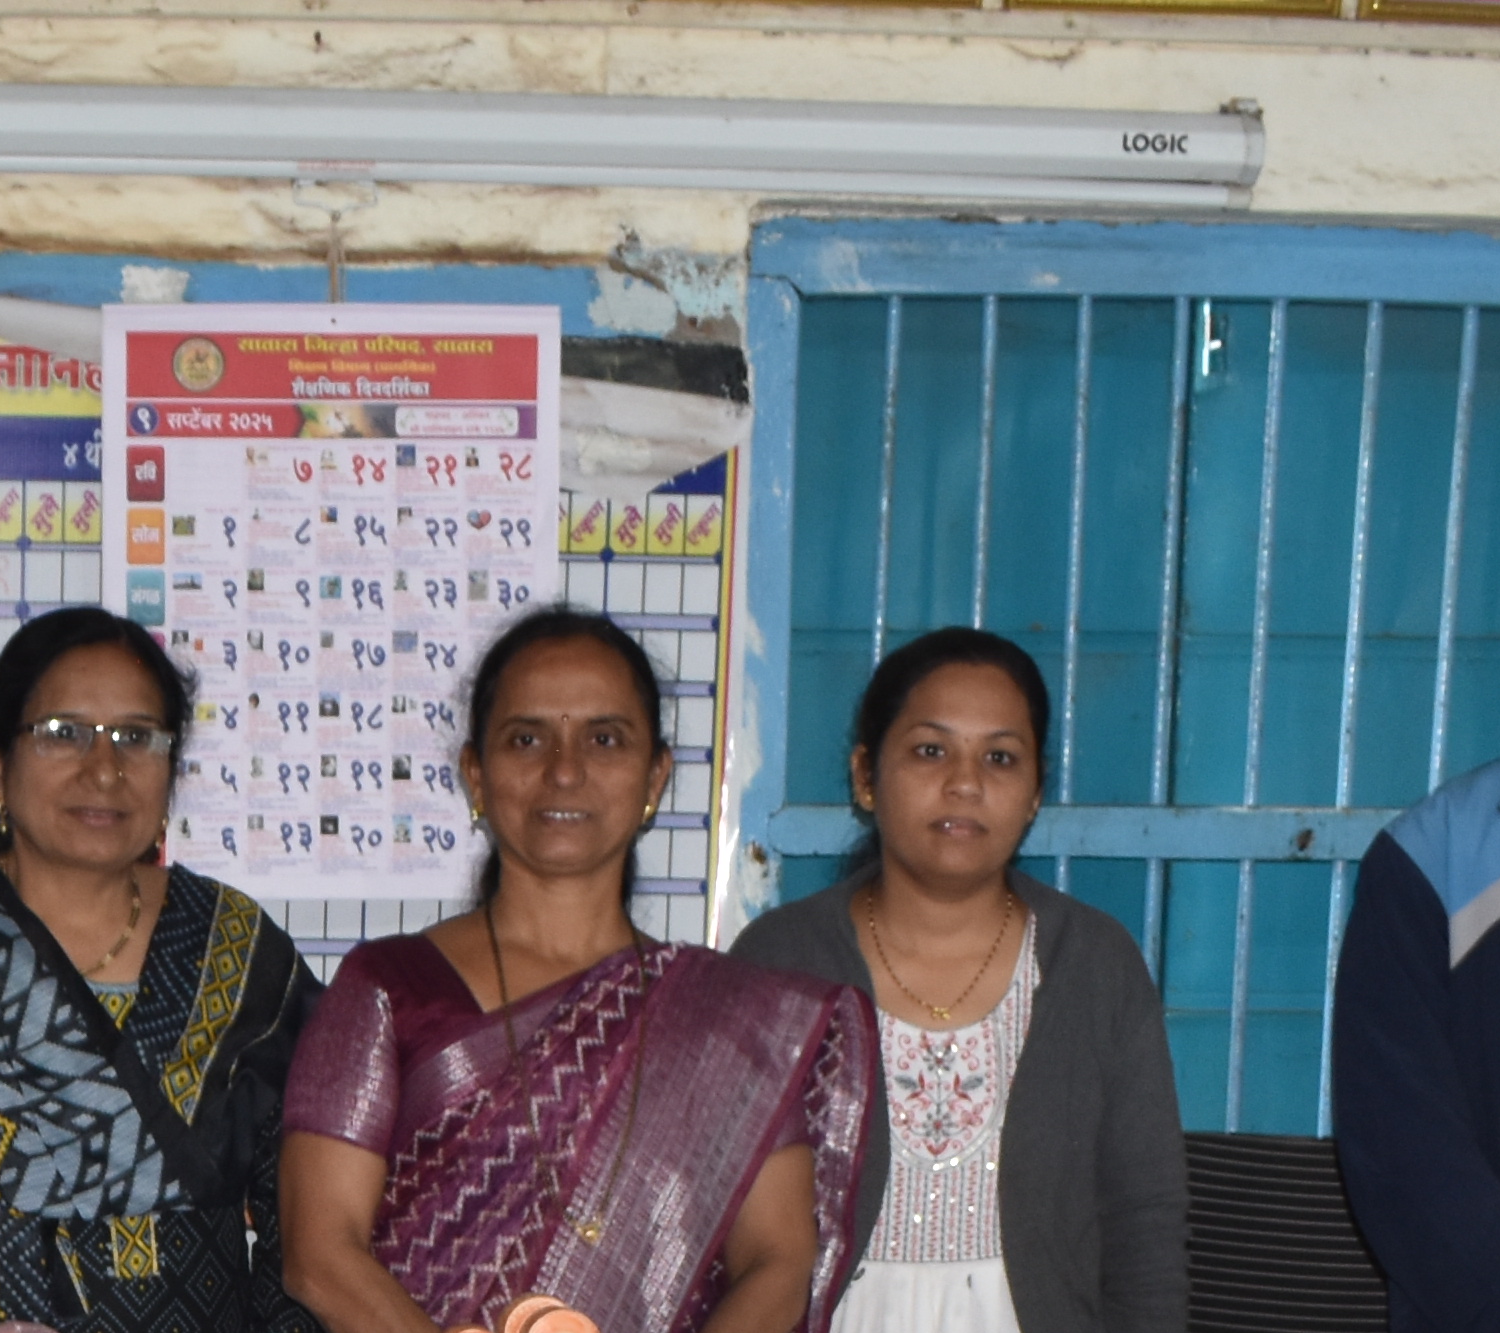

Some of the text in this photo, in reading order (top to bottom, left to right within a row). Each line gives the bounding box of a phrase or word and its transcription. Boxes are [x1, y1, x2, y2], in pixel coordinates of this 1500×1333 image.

[1120, 131, 1190, 155] LOGIC
[292, 376, 431, 398] शैक्षणिक दिनदर्शिका
[136, 405, 274, 433] ९ सप्टेंबर २०२५
[134, 452, 532, 487] रवि ७ १४ २१ २८
[222, 515, 238, 548] १
[294, 517, 312, 545] ८
[354, 514, 388, 547] १५
[425, 517, 459, 548] २२
[500, 516, 532, 548] २९
[222, 579, 238, 609] २
[295, 578, 311, 609] ९
[352, 578, 384, 611] १६
[425, 578, 458, 609] २३
[498, 578, 530, 611] ३०
[222, 638, 458, 671] ३ १० १७ २४
[220, 700, 456, 733] ४ ११ १८ २५
[220, 760, 455, 794] ५ १२ १९ २६
[221, 821, 456, 857] ६ १३ २० २७
